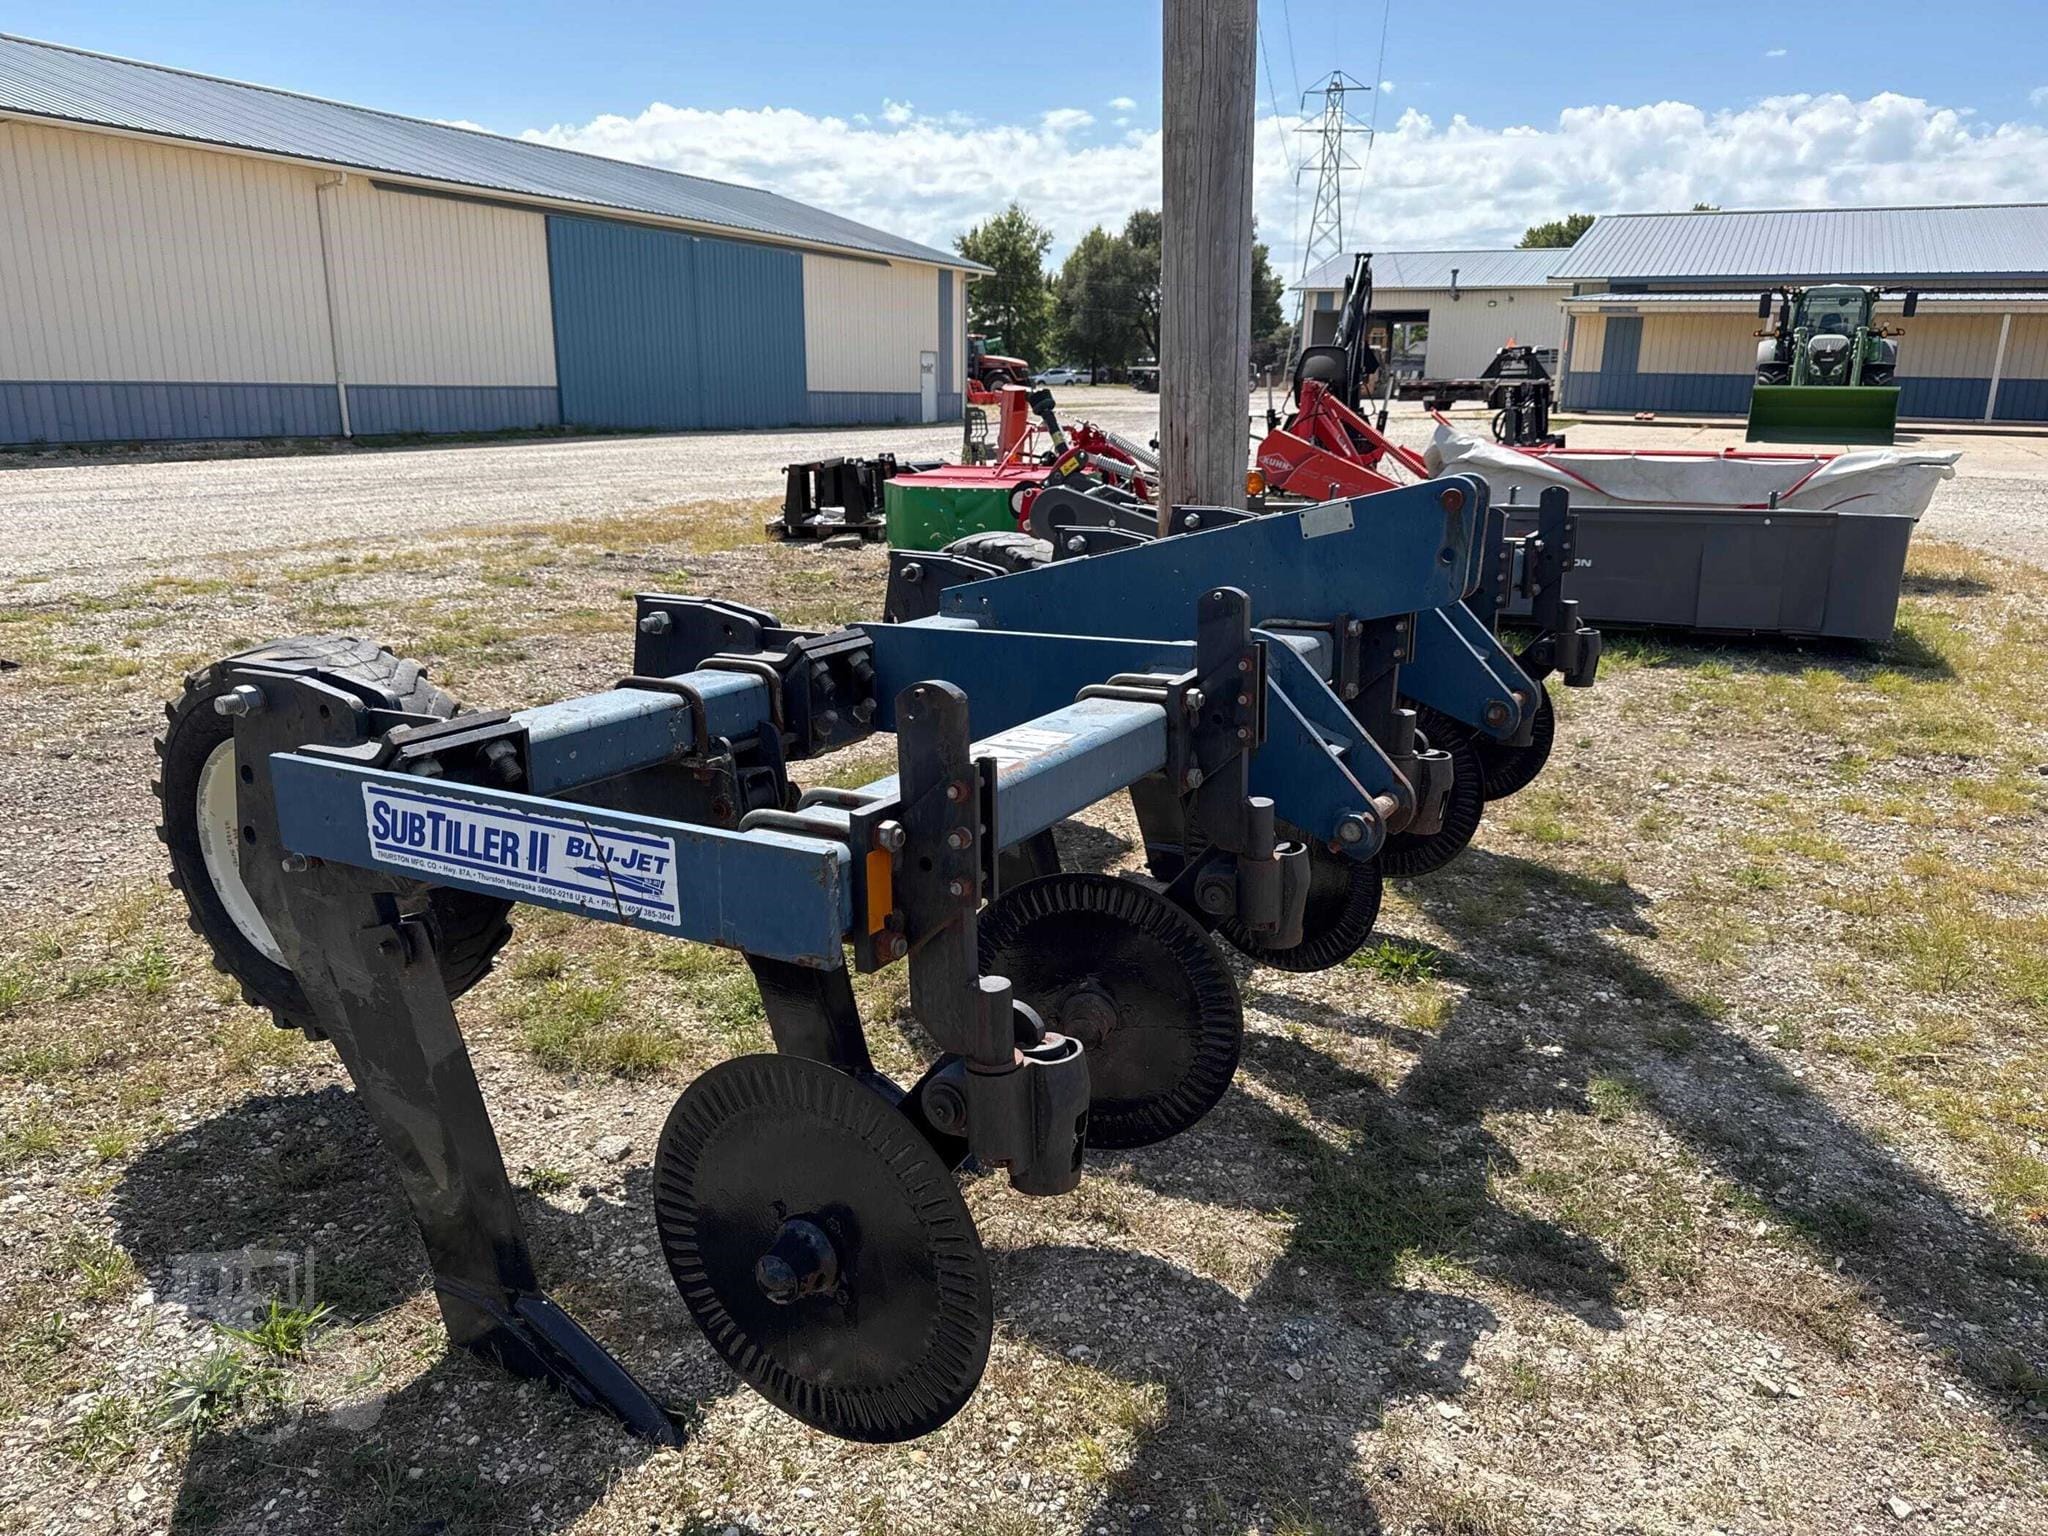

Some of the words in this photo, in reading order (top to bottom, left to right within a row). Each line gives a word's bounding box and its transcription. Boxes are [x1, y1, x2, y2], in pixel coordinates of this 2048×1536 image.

[1263, 456, 1290, 470] KUHN
[377, 850, 410, 863] THURSTON
[478, 872, 506, 884] Thurston
[507, 879, 536, 891] Nebraska
[527, 830, 550, 874] II
[565, 836, 670, 875] BLU-JET
